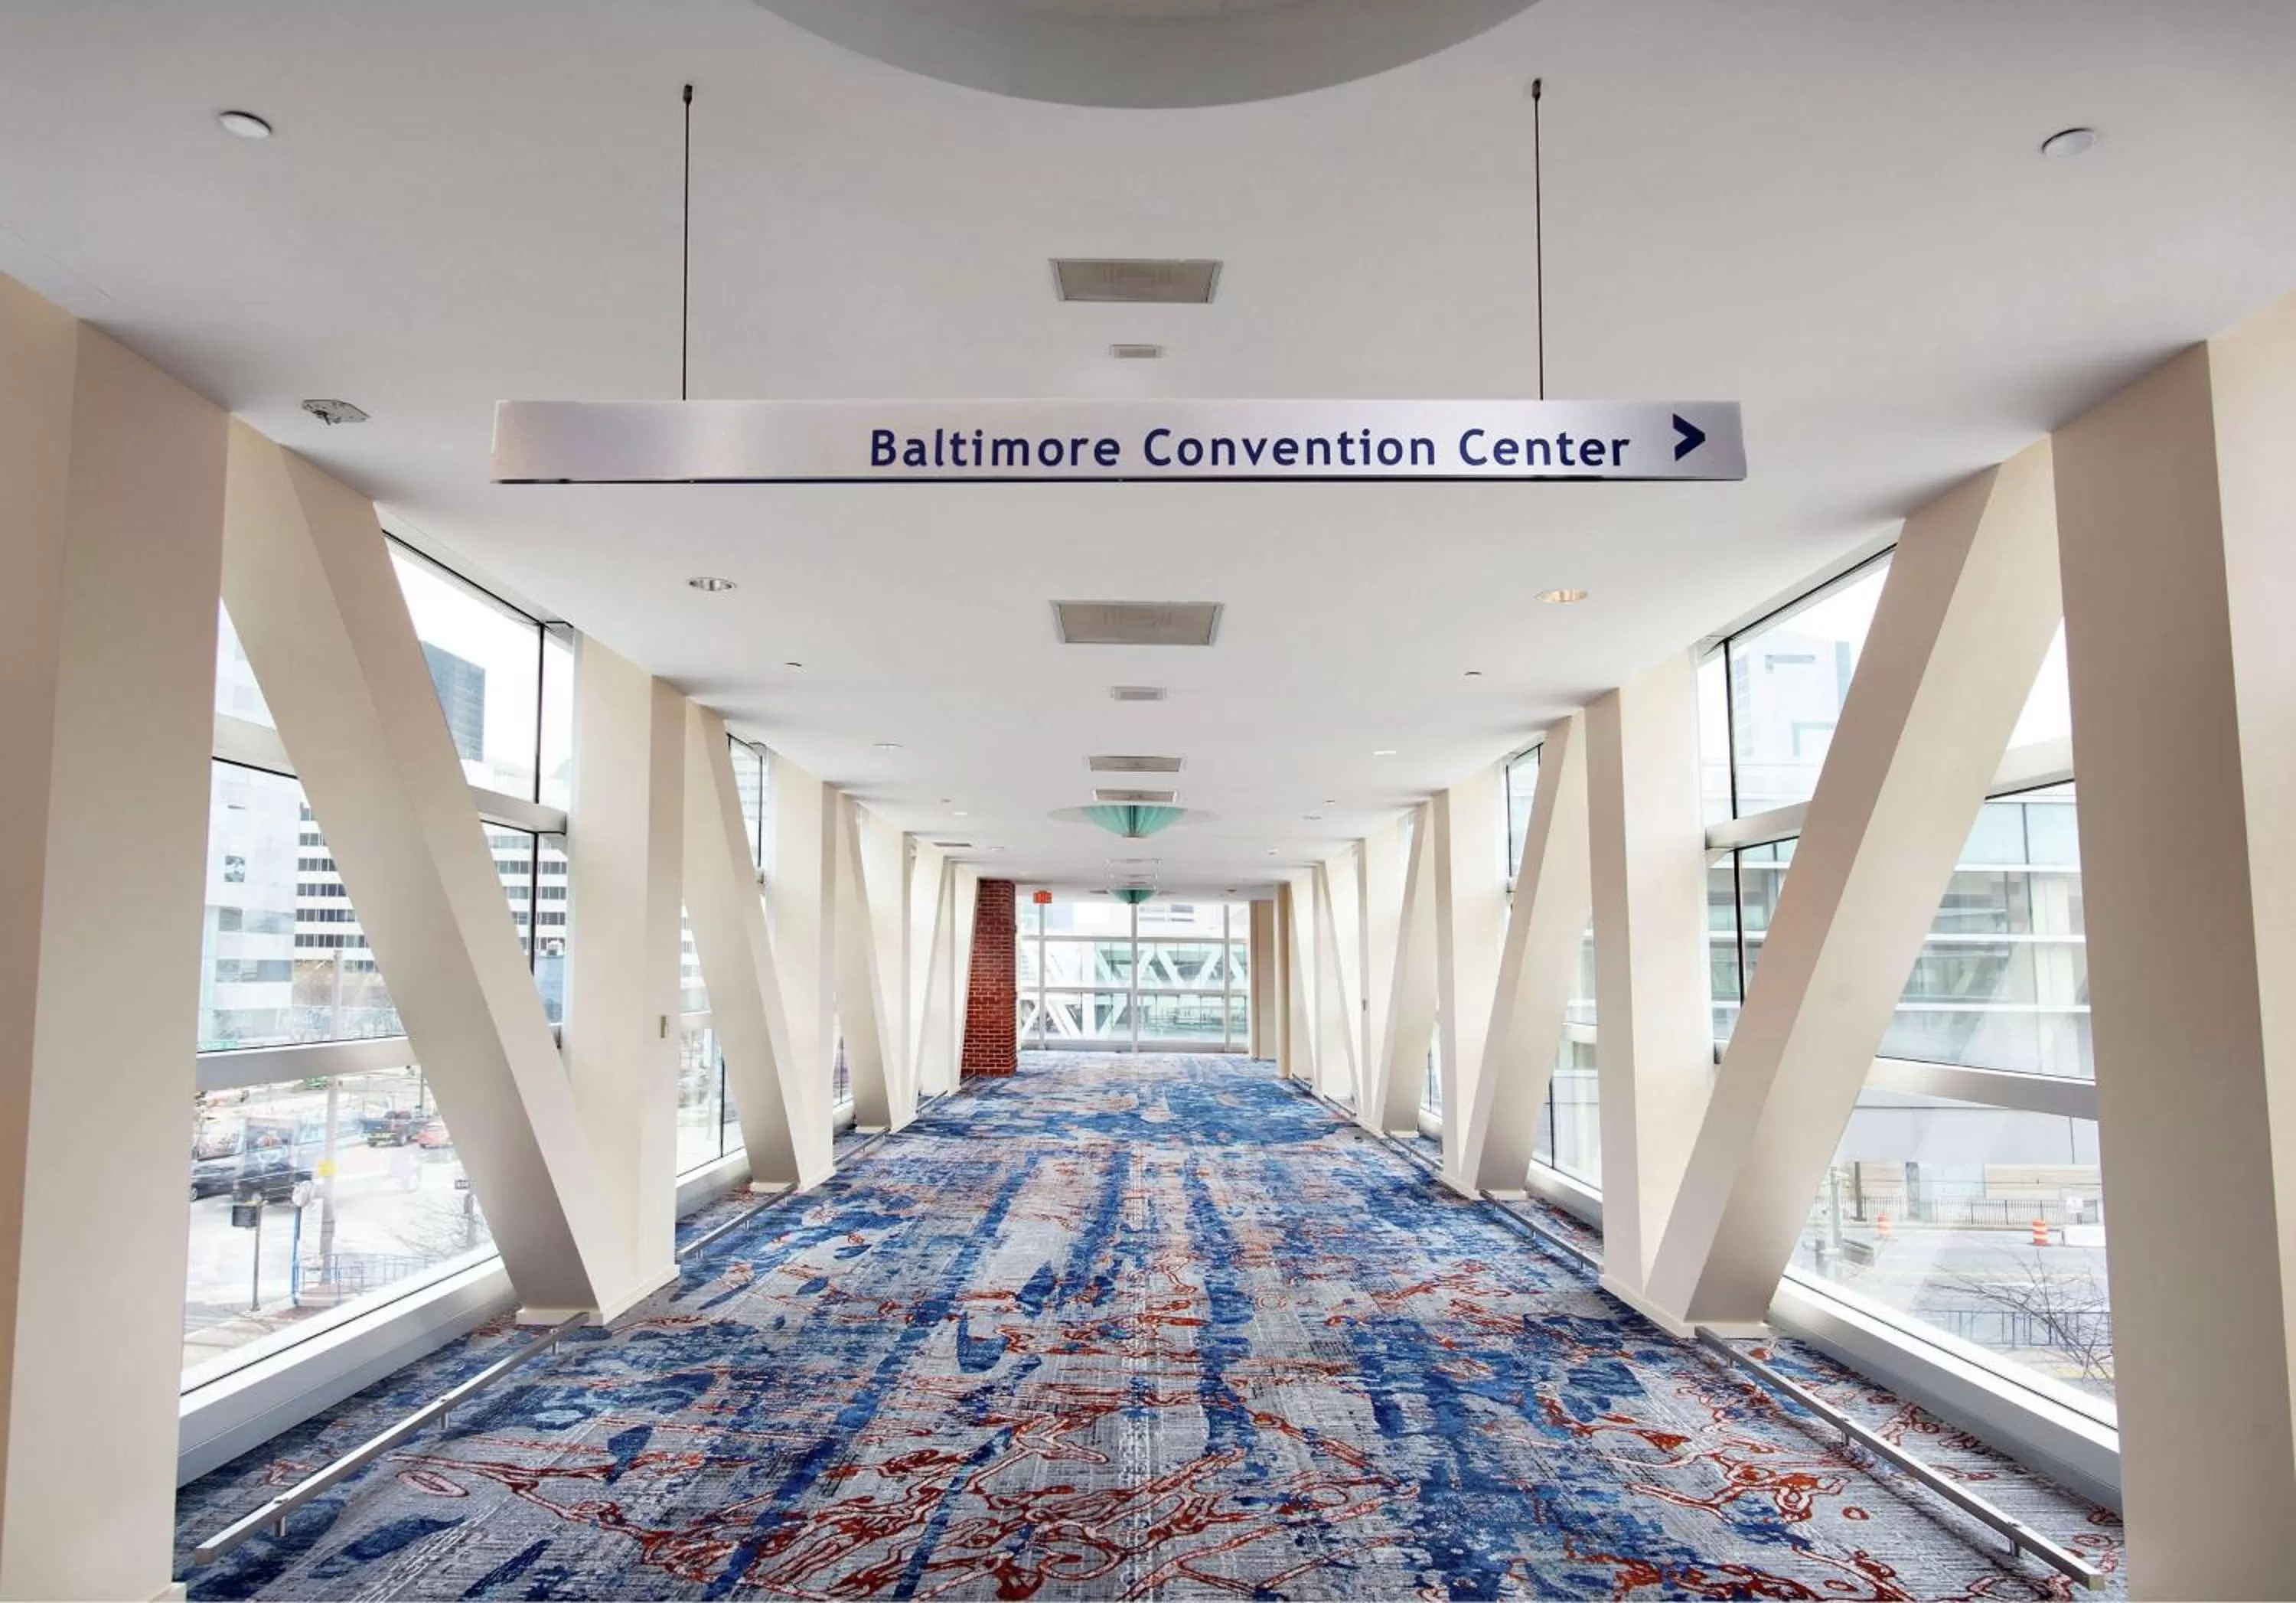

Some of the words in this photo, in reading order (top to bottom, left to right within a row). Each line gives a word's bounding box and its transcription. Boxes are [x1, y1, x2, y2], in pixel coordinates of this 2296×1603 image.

[871, 428, 1120, 467] Baltimore
[1144, 427, 1435, 466] Convention
[1459, 428, 1630, 466] Center
